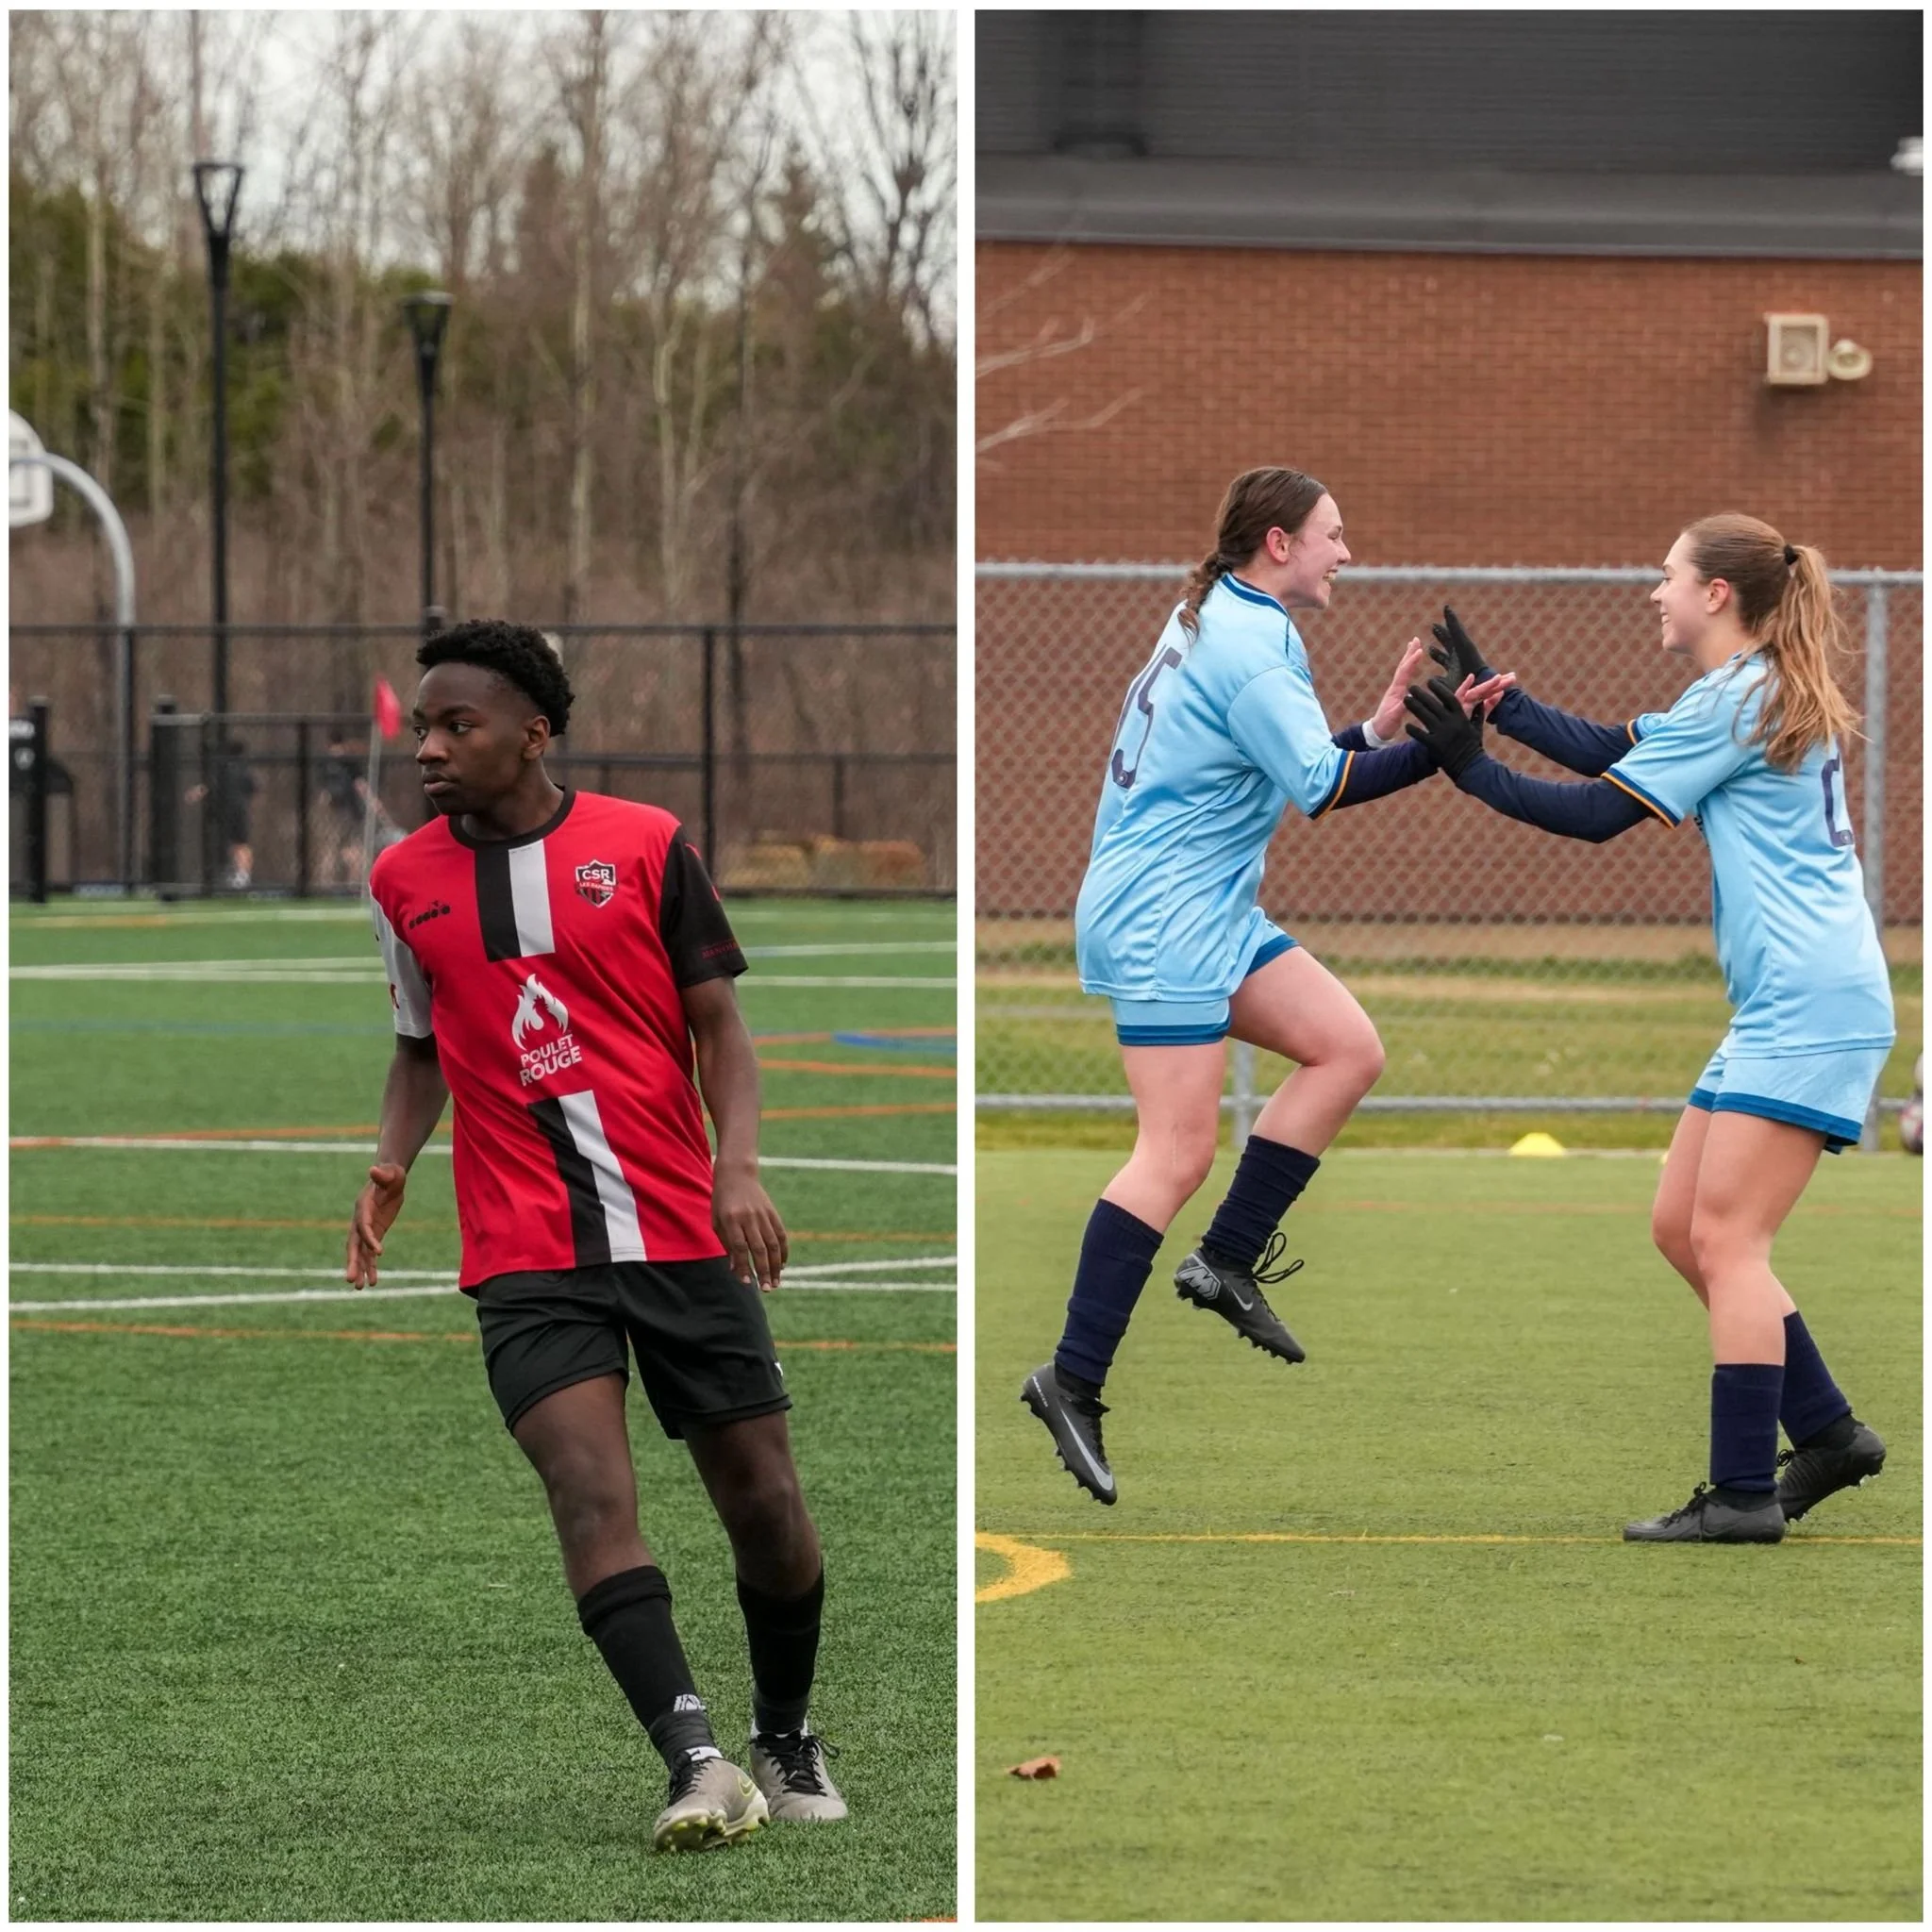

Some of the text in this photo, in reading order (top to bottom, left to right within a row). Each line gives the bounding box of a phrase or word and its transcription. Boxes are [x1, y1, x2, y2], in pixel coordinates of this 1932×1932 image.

[582, 869, 610, 880] CSR
[520, 1034, 573, 1068] POULET
[520, 1045, 582, 1087] ROUGE
